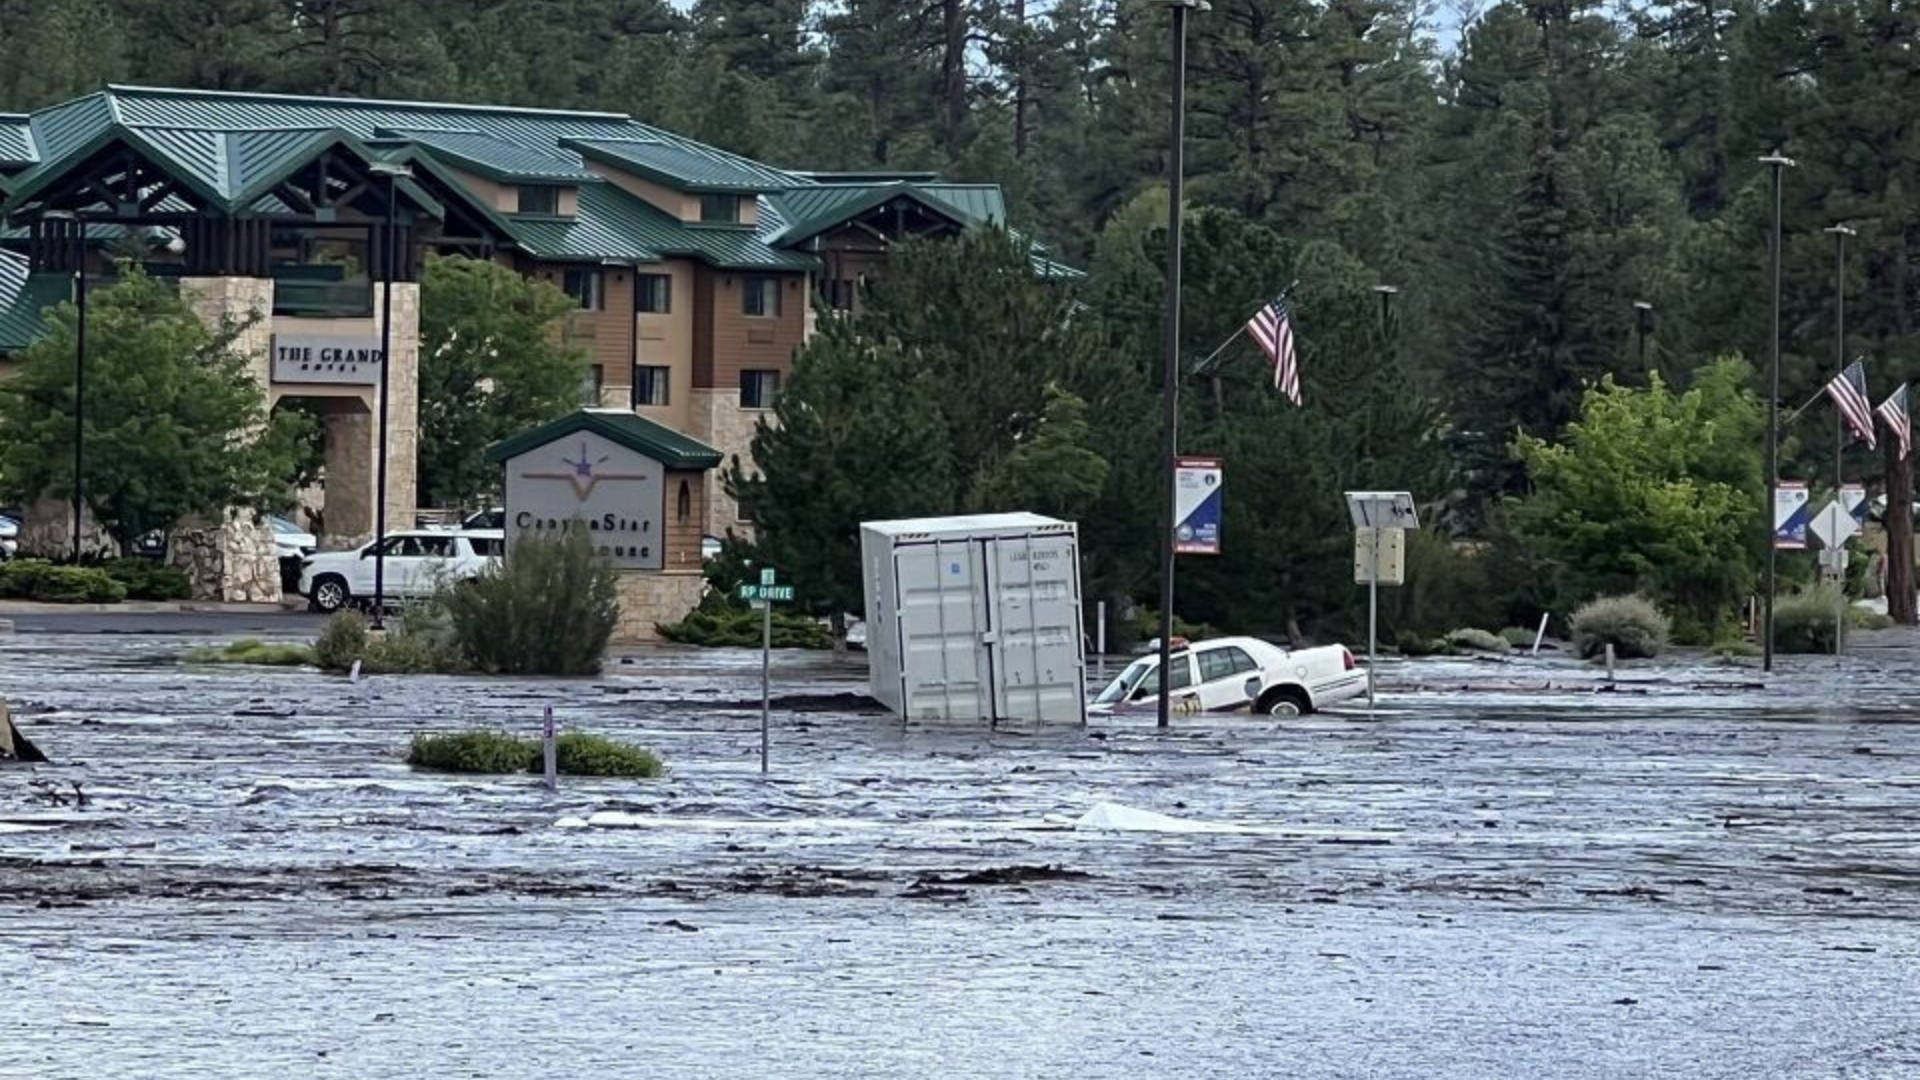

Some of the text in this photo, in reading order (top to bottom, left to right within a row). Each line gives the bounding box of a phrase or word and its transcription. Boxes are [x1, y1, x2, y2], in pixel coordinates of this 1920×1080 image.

[279, 347, 383, 363] THE GRAND
[516, 511, 650, 535] CanynStar
